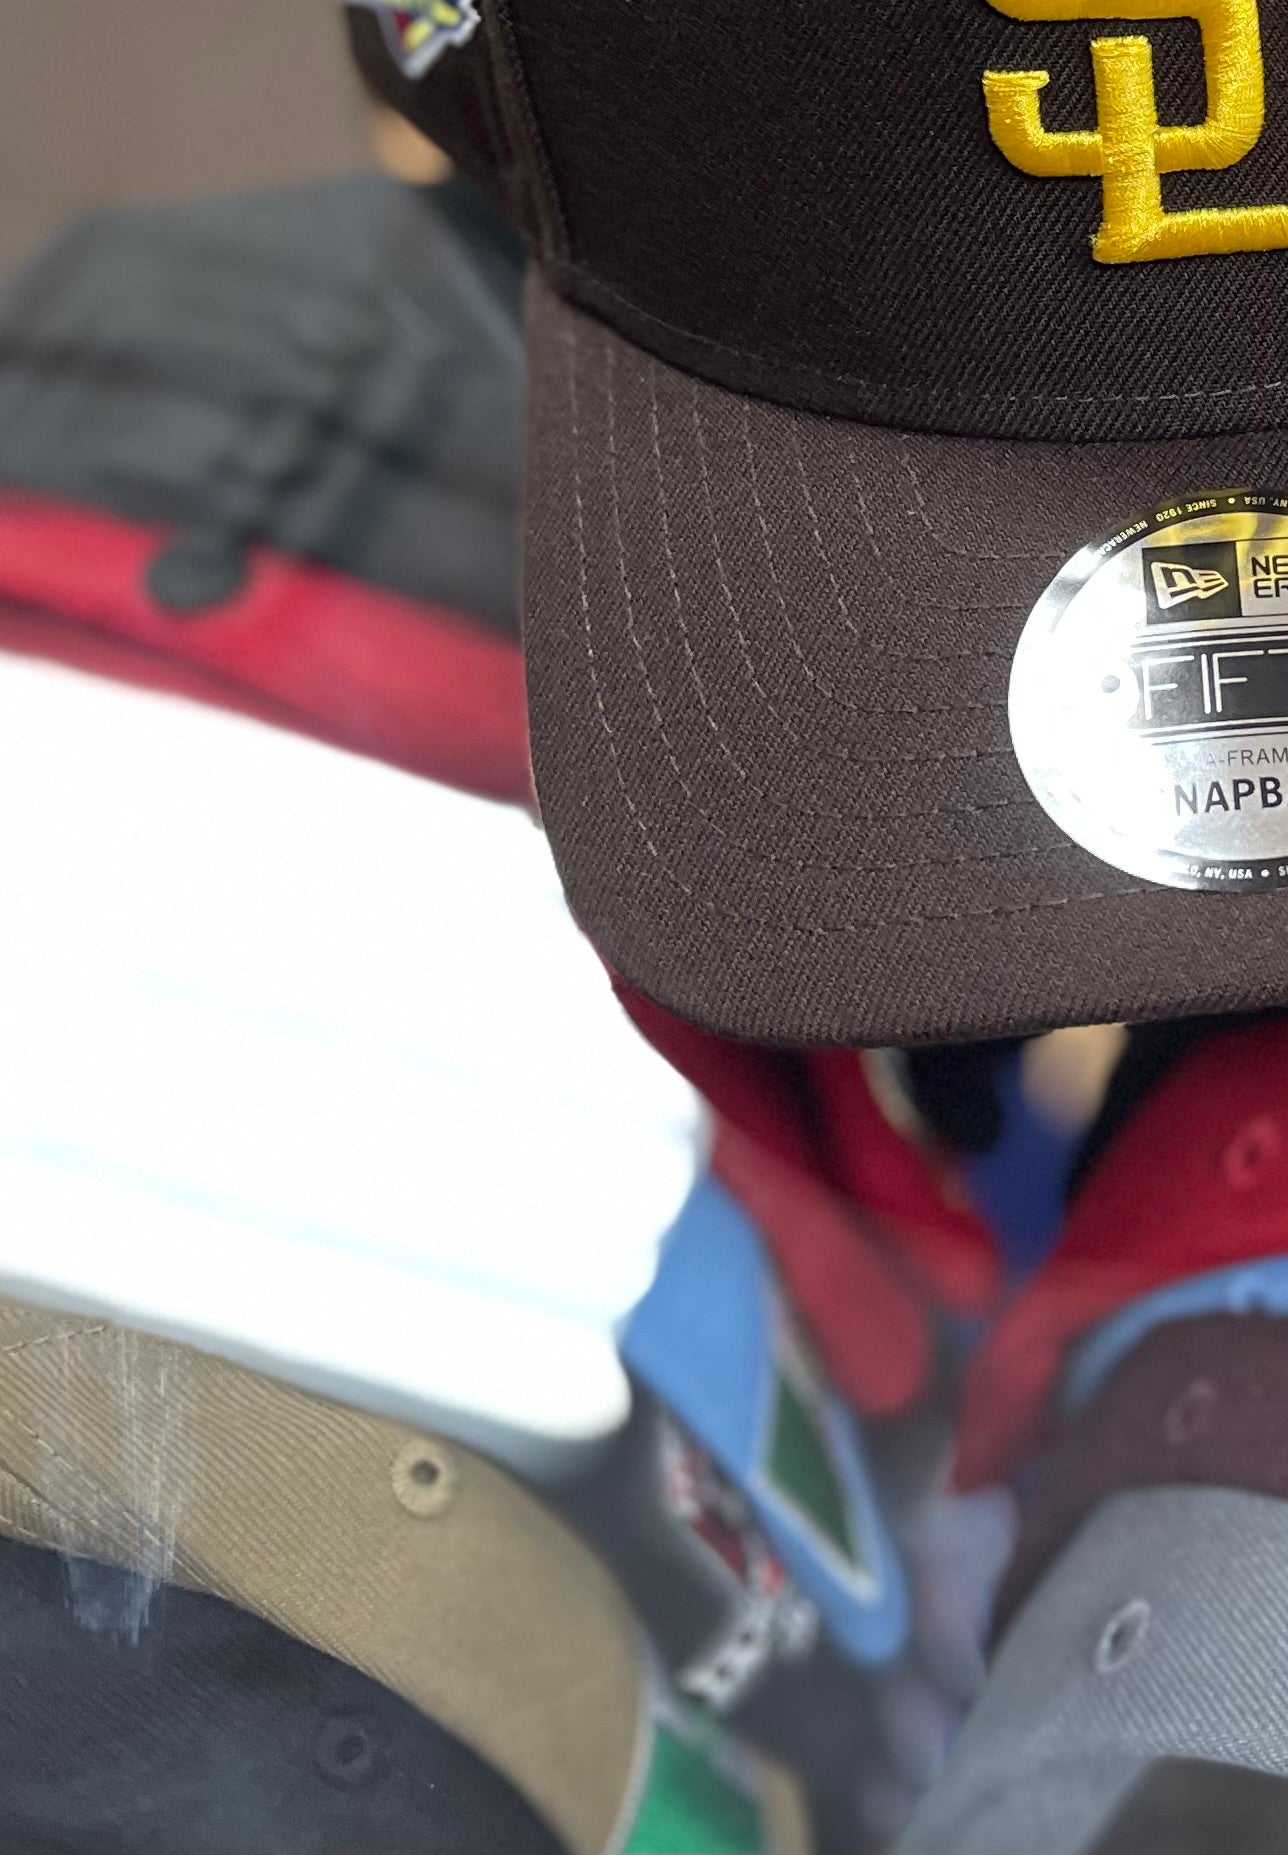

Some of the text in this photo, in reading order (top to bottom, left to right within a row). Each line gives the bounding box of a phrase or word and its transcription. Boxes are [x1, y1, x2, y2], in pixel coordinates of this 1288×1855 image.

[1187, 498, 1218, 513] SINCE
[1243, 496, 1267, 506] USA
[1155, 507, 1184, 523] 1920
[1228, 867, 1255, 881] USA
